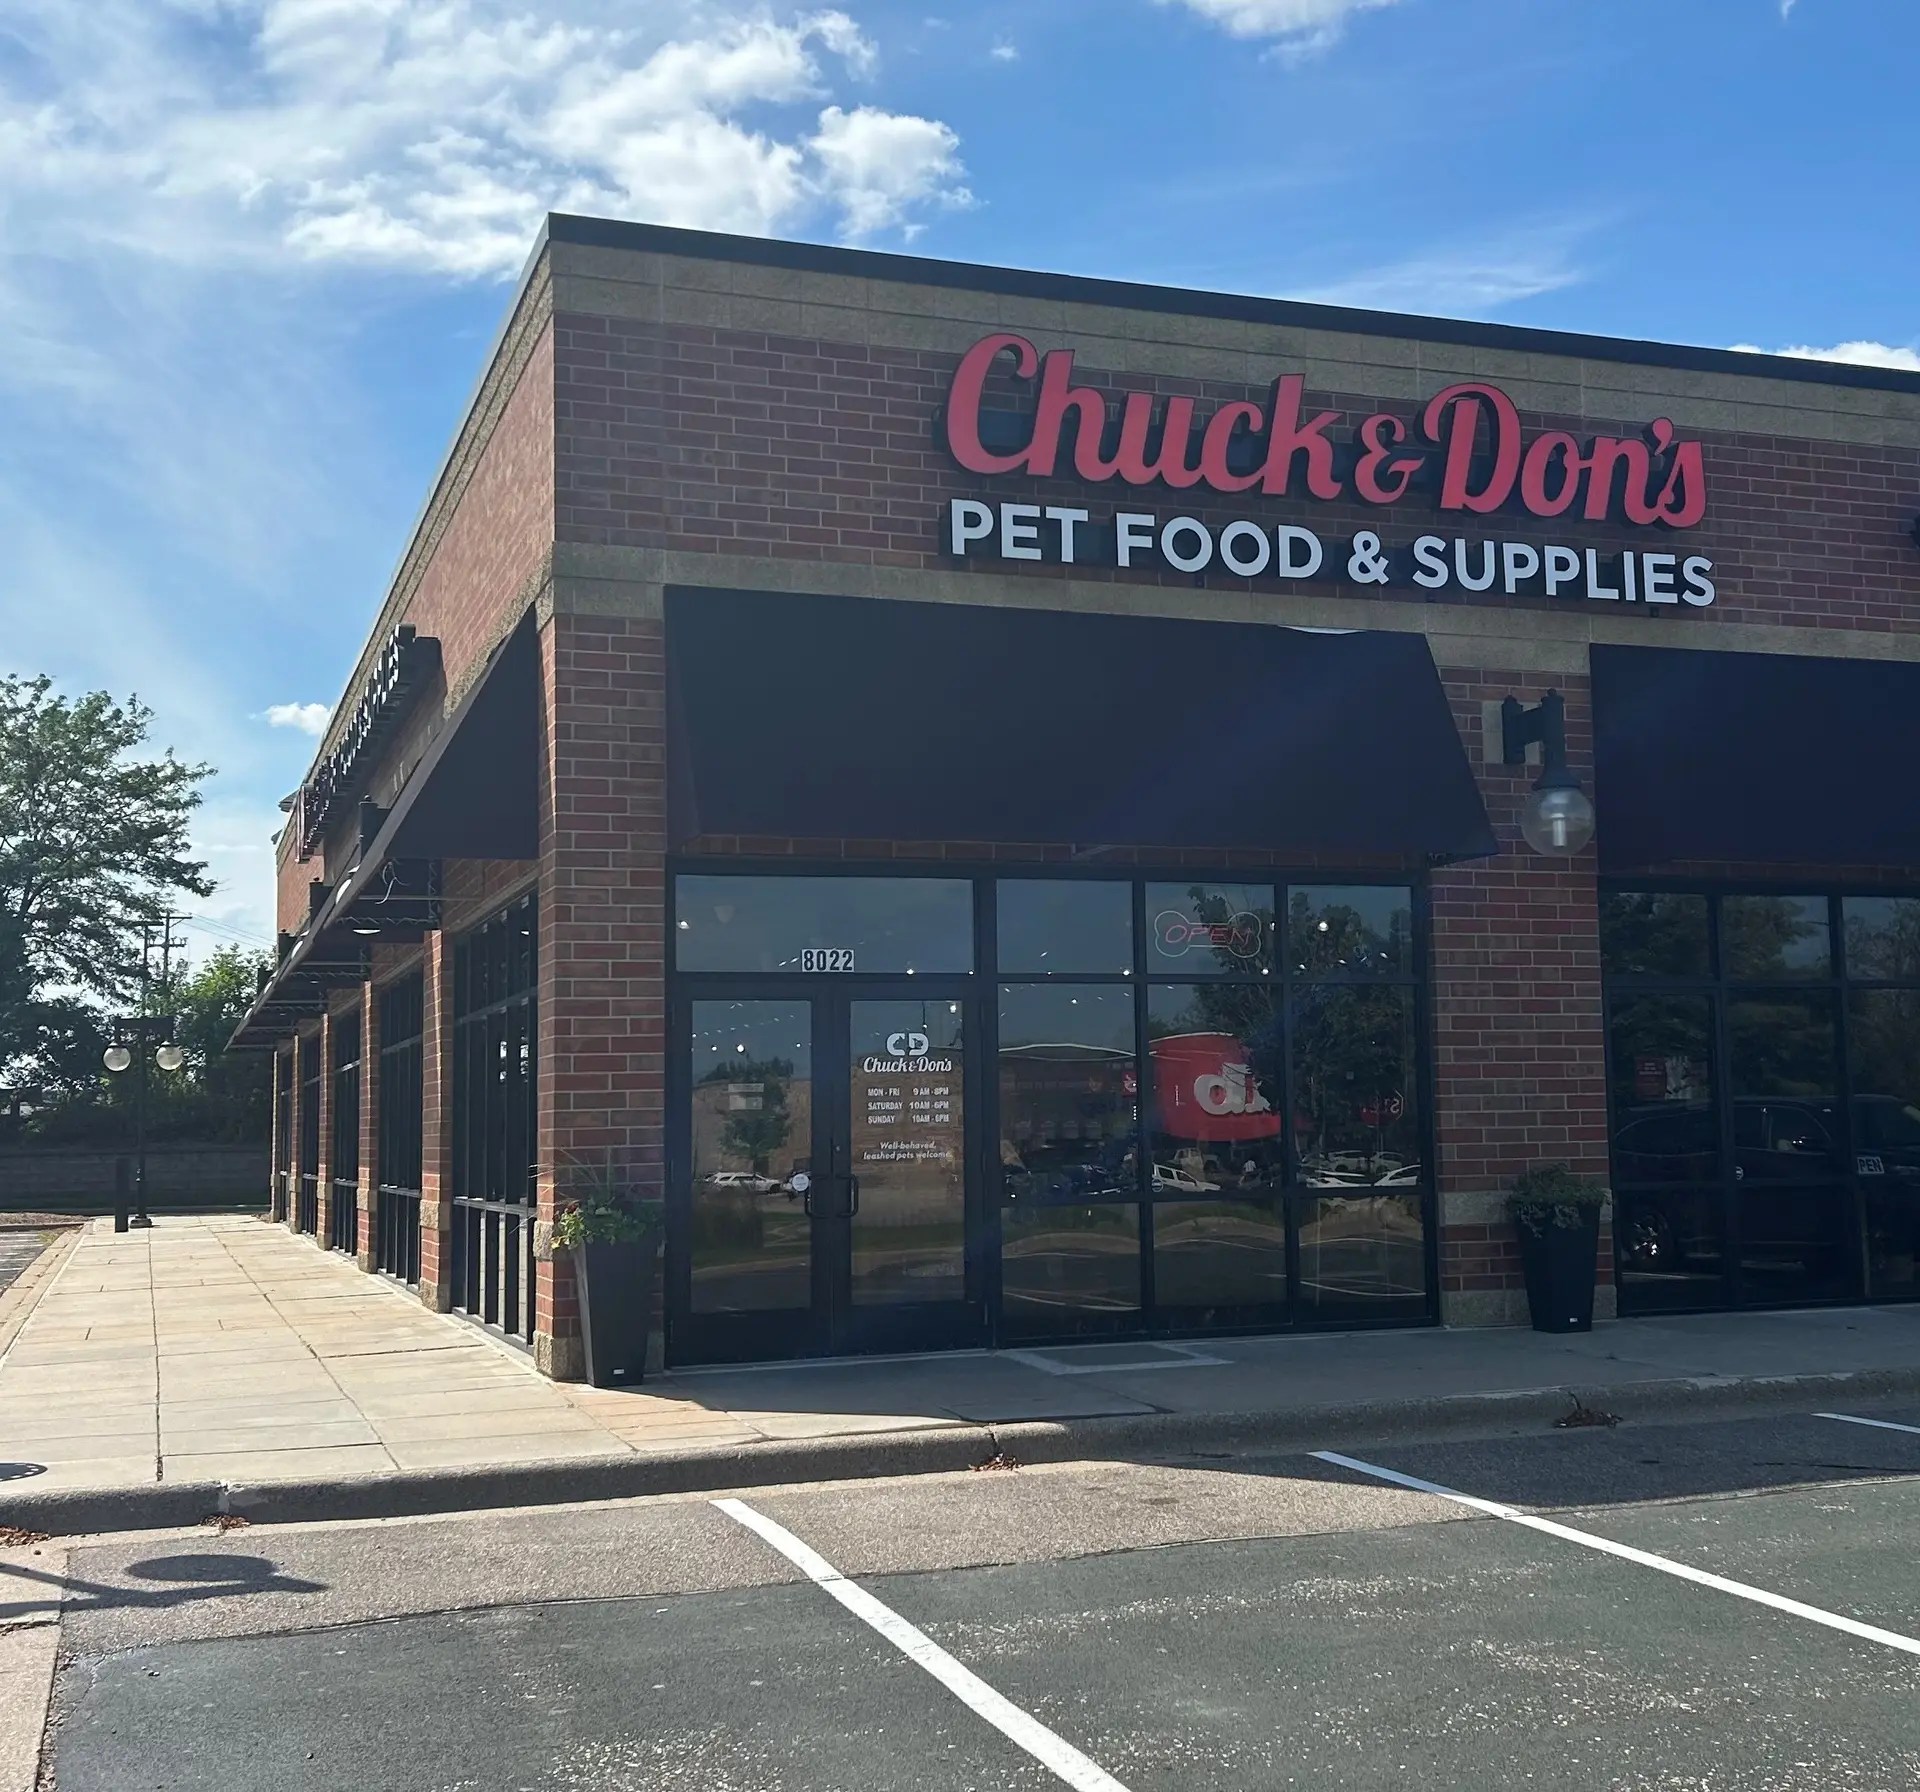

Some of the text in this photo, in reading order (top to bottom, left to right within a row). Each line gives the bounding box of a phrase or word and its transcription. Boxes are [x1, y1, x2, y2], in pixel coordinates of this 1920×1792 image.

[945, 333, 1708, 529] Chuck & Don's
[951, 498, 1717, 608] PET FOOD & SUPPLIES
[1165, 924, 1252, 947] OPEN
[803, 949, 854, 972] 8022
[863, 1057, 907, 1073] Chuck
[917, 1056, 952, 1072] Don's
[867, 1088, 884, 1097] MON
[888, 1087, 900, 1096] FRI
[867, 1101, 903, 1111] SATURDAY
[867, 1115, 896, 1124] SUNDAY
[863, 1152, 896, 1161] leashed
[896, 1152, 914, 1161] pets
